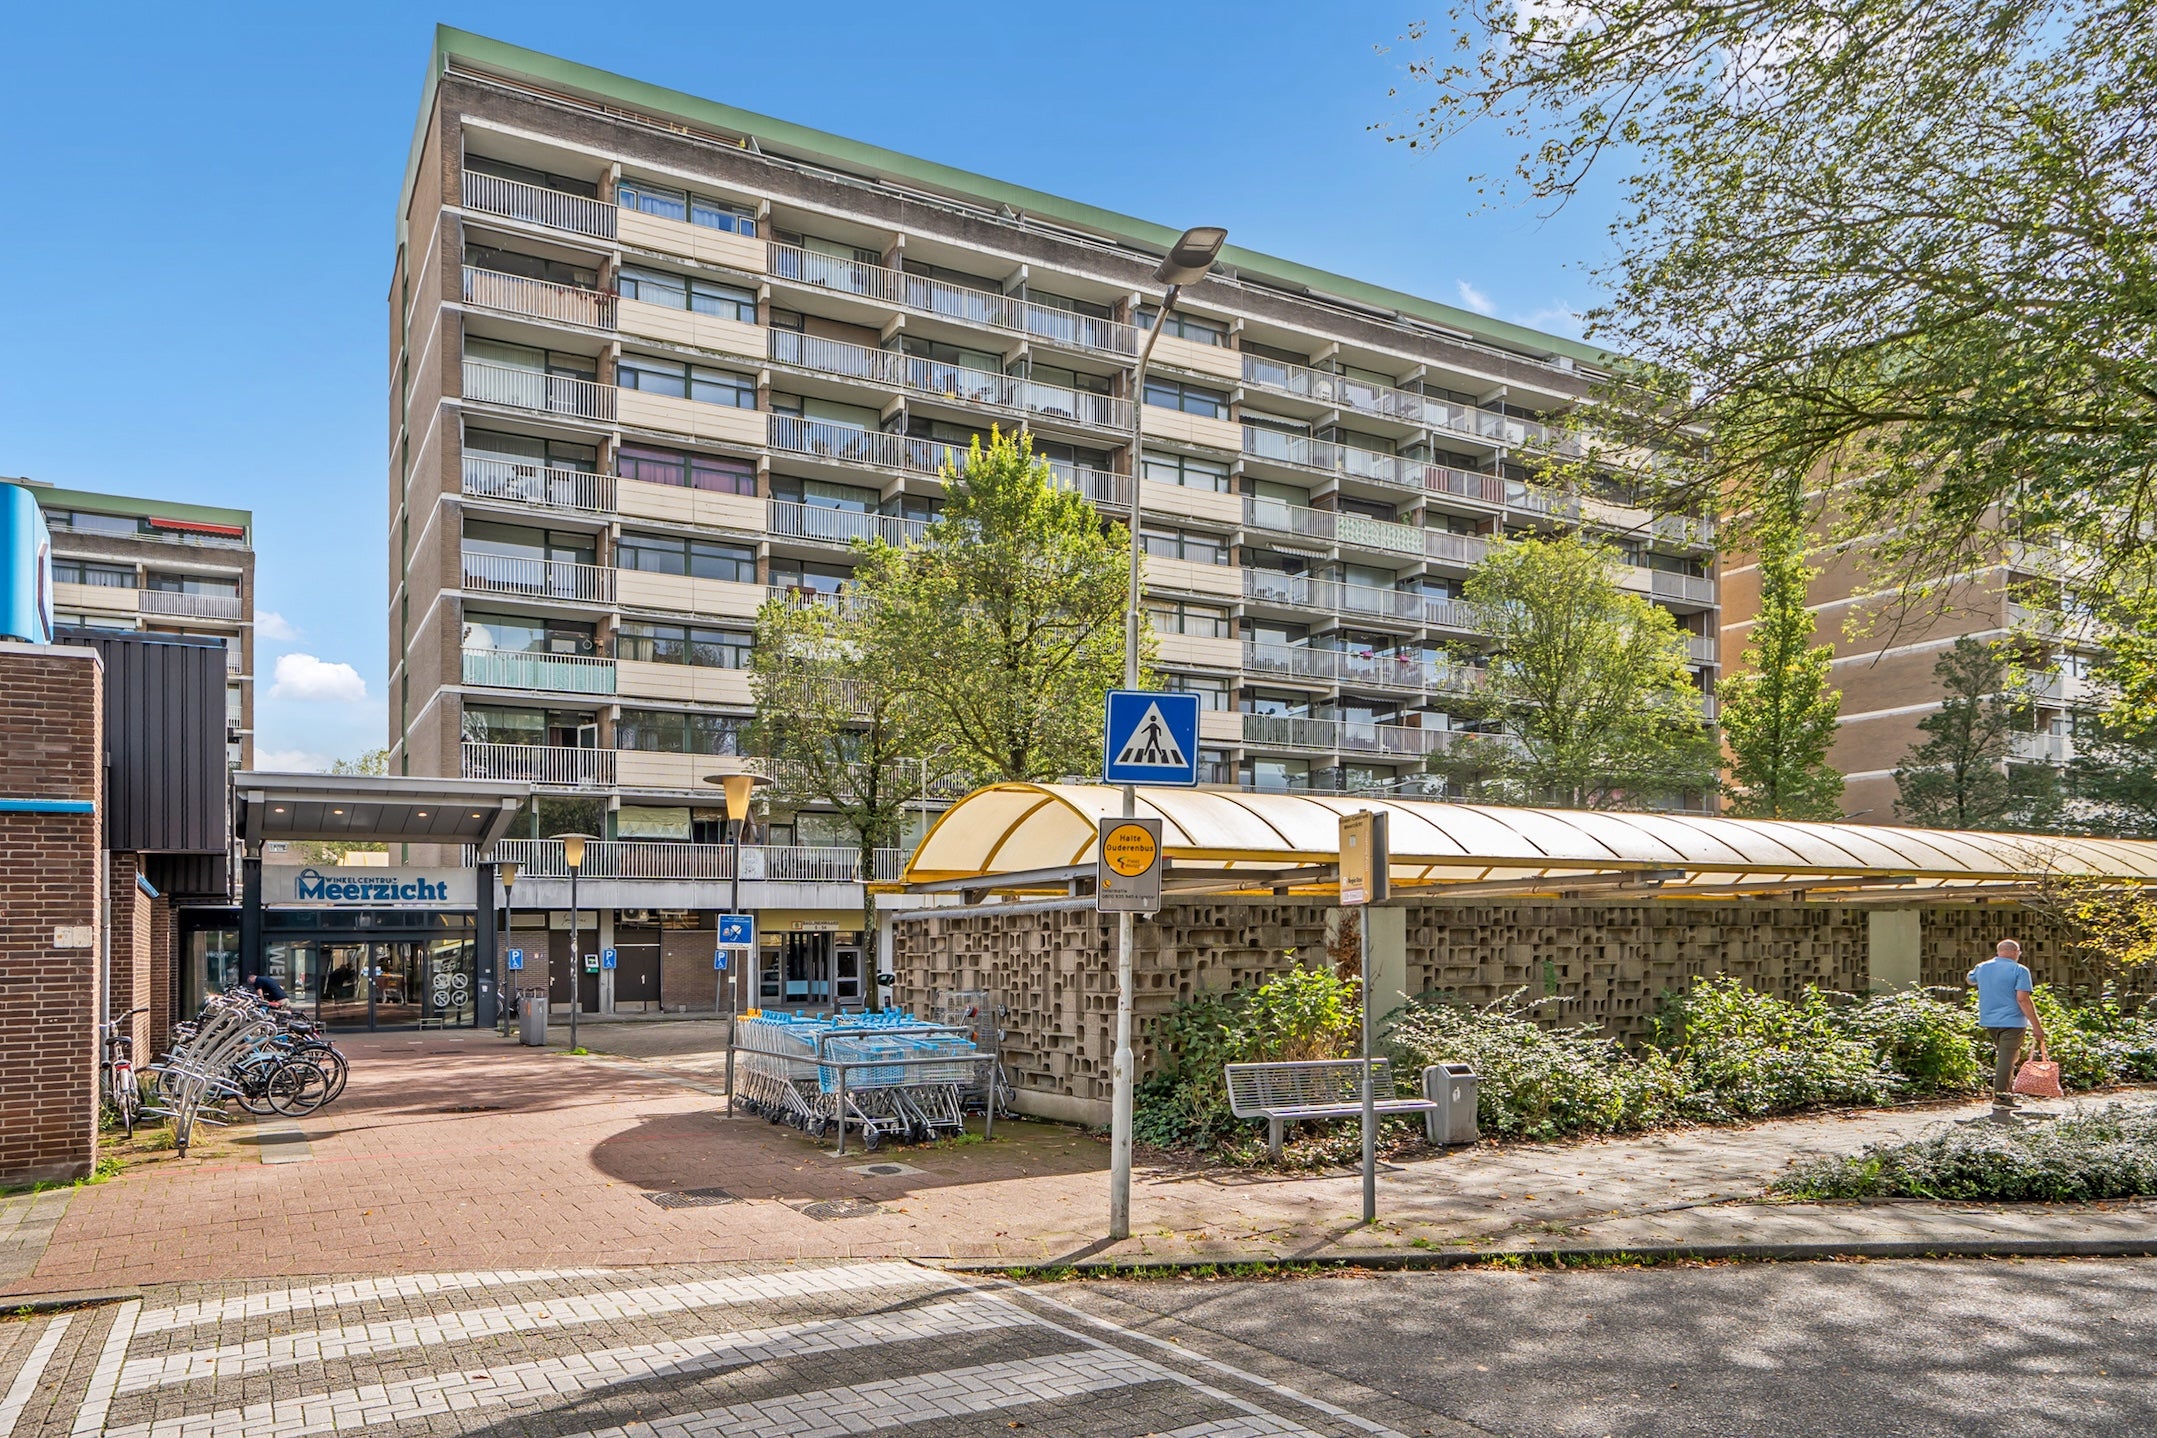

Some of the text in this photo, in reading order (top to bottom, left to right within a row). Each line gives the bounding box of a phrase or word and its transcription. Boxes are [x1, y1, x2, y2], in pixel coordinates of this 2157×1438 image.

[1106, 844, 1154, 852] Ouderenbus
[297, 875, 448, 901] Meerzicht
[512, 951, 519, 960] P
[606, 951, 613, 960] P
[718, 953, 725, 961] P
[269, 946, 286, 982] WEL
